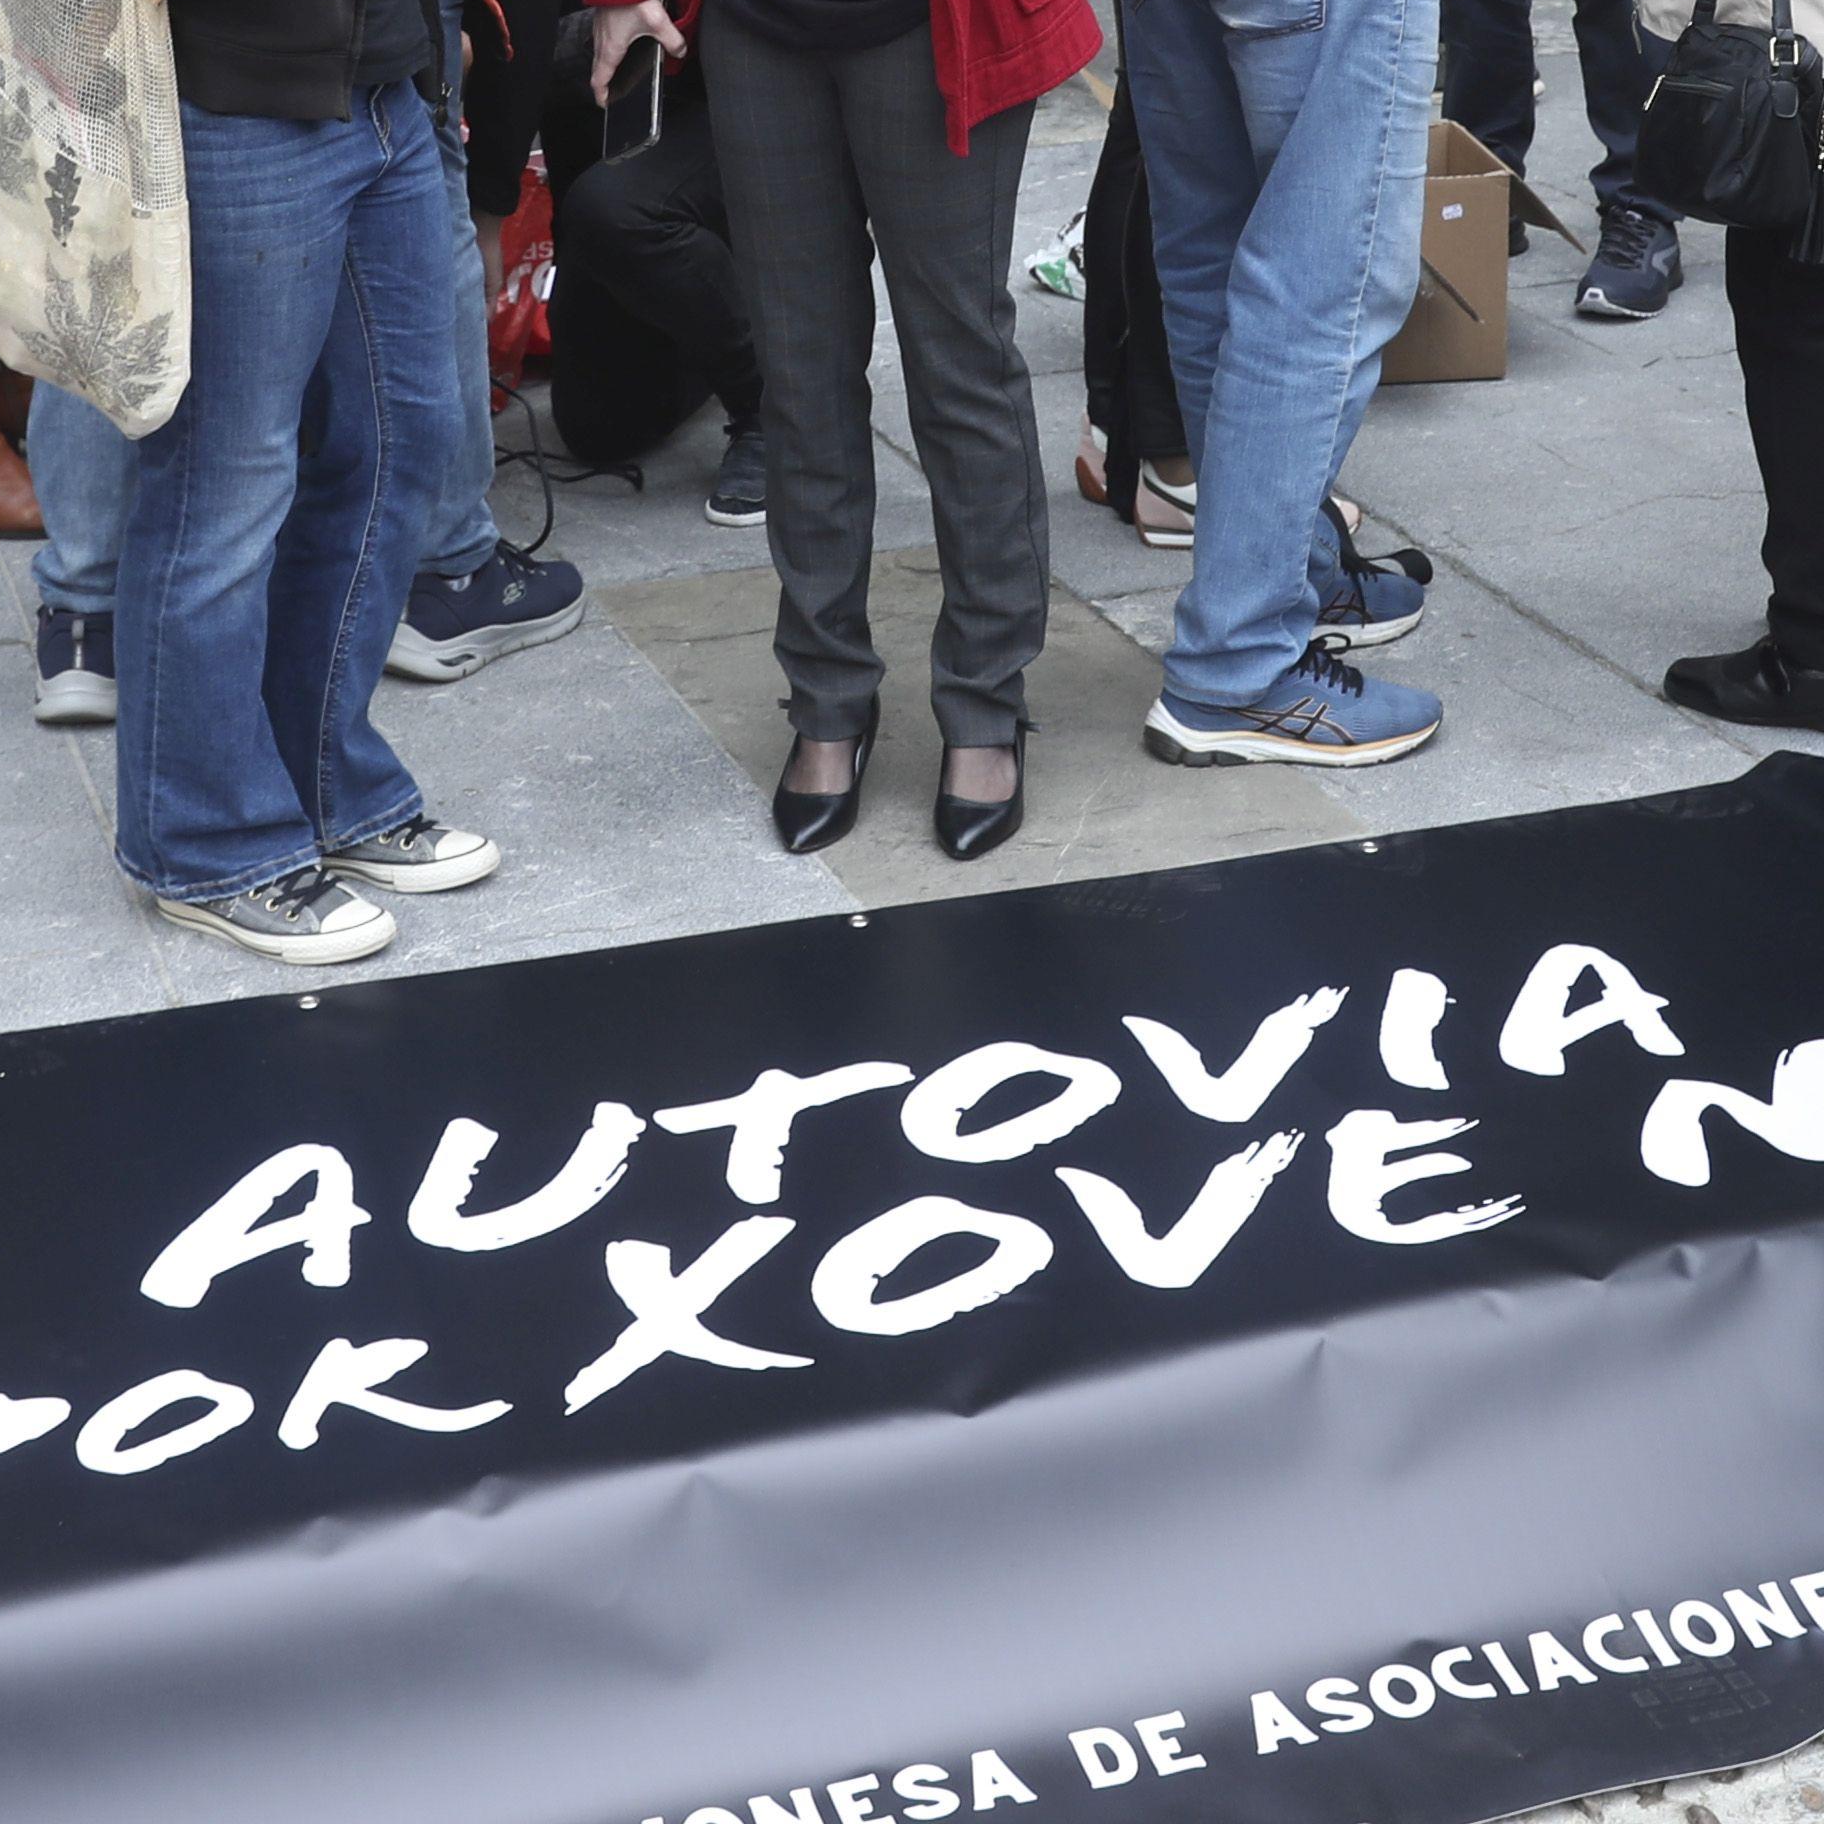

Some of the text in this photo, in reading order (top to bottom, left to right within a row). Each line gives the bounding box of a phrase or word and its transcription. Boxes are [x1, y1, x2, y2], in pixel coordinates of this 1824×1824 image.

[140, 944, 1685, 1308] AUTOVIA
[564, 1110, 1526, 1415] XOVE
[1068, 1710, 1207, 1789] DE
